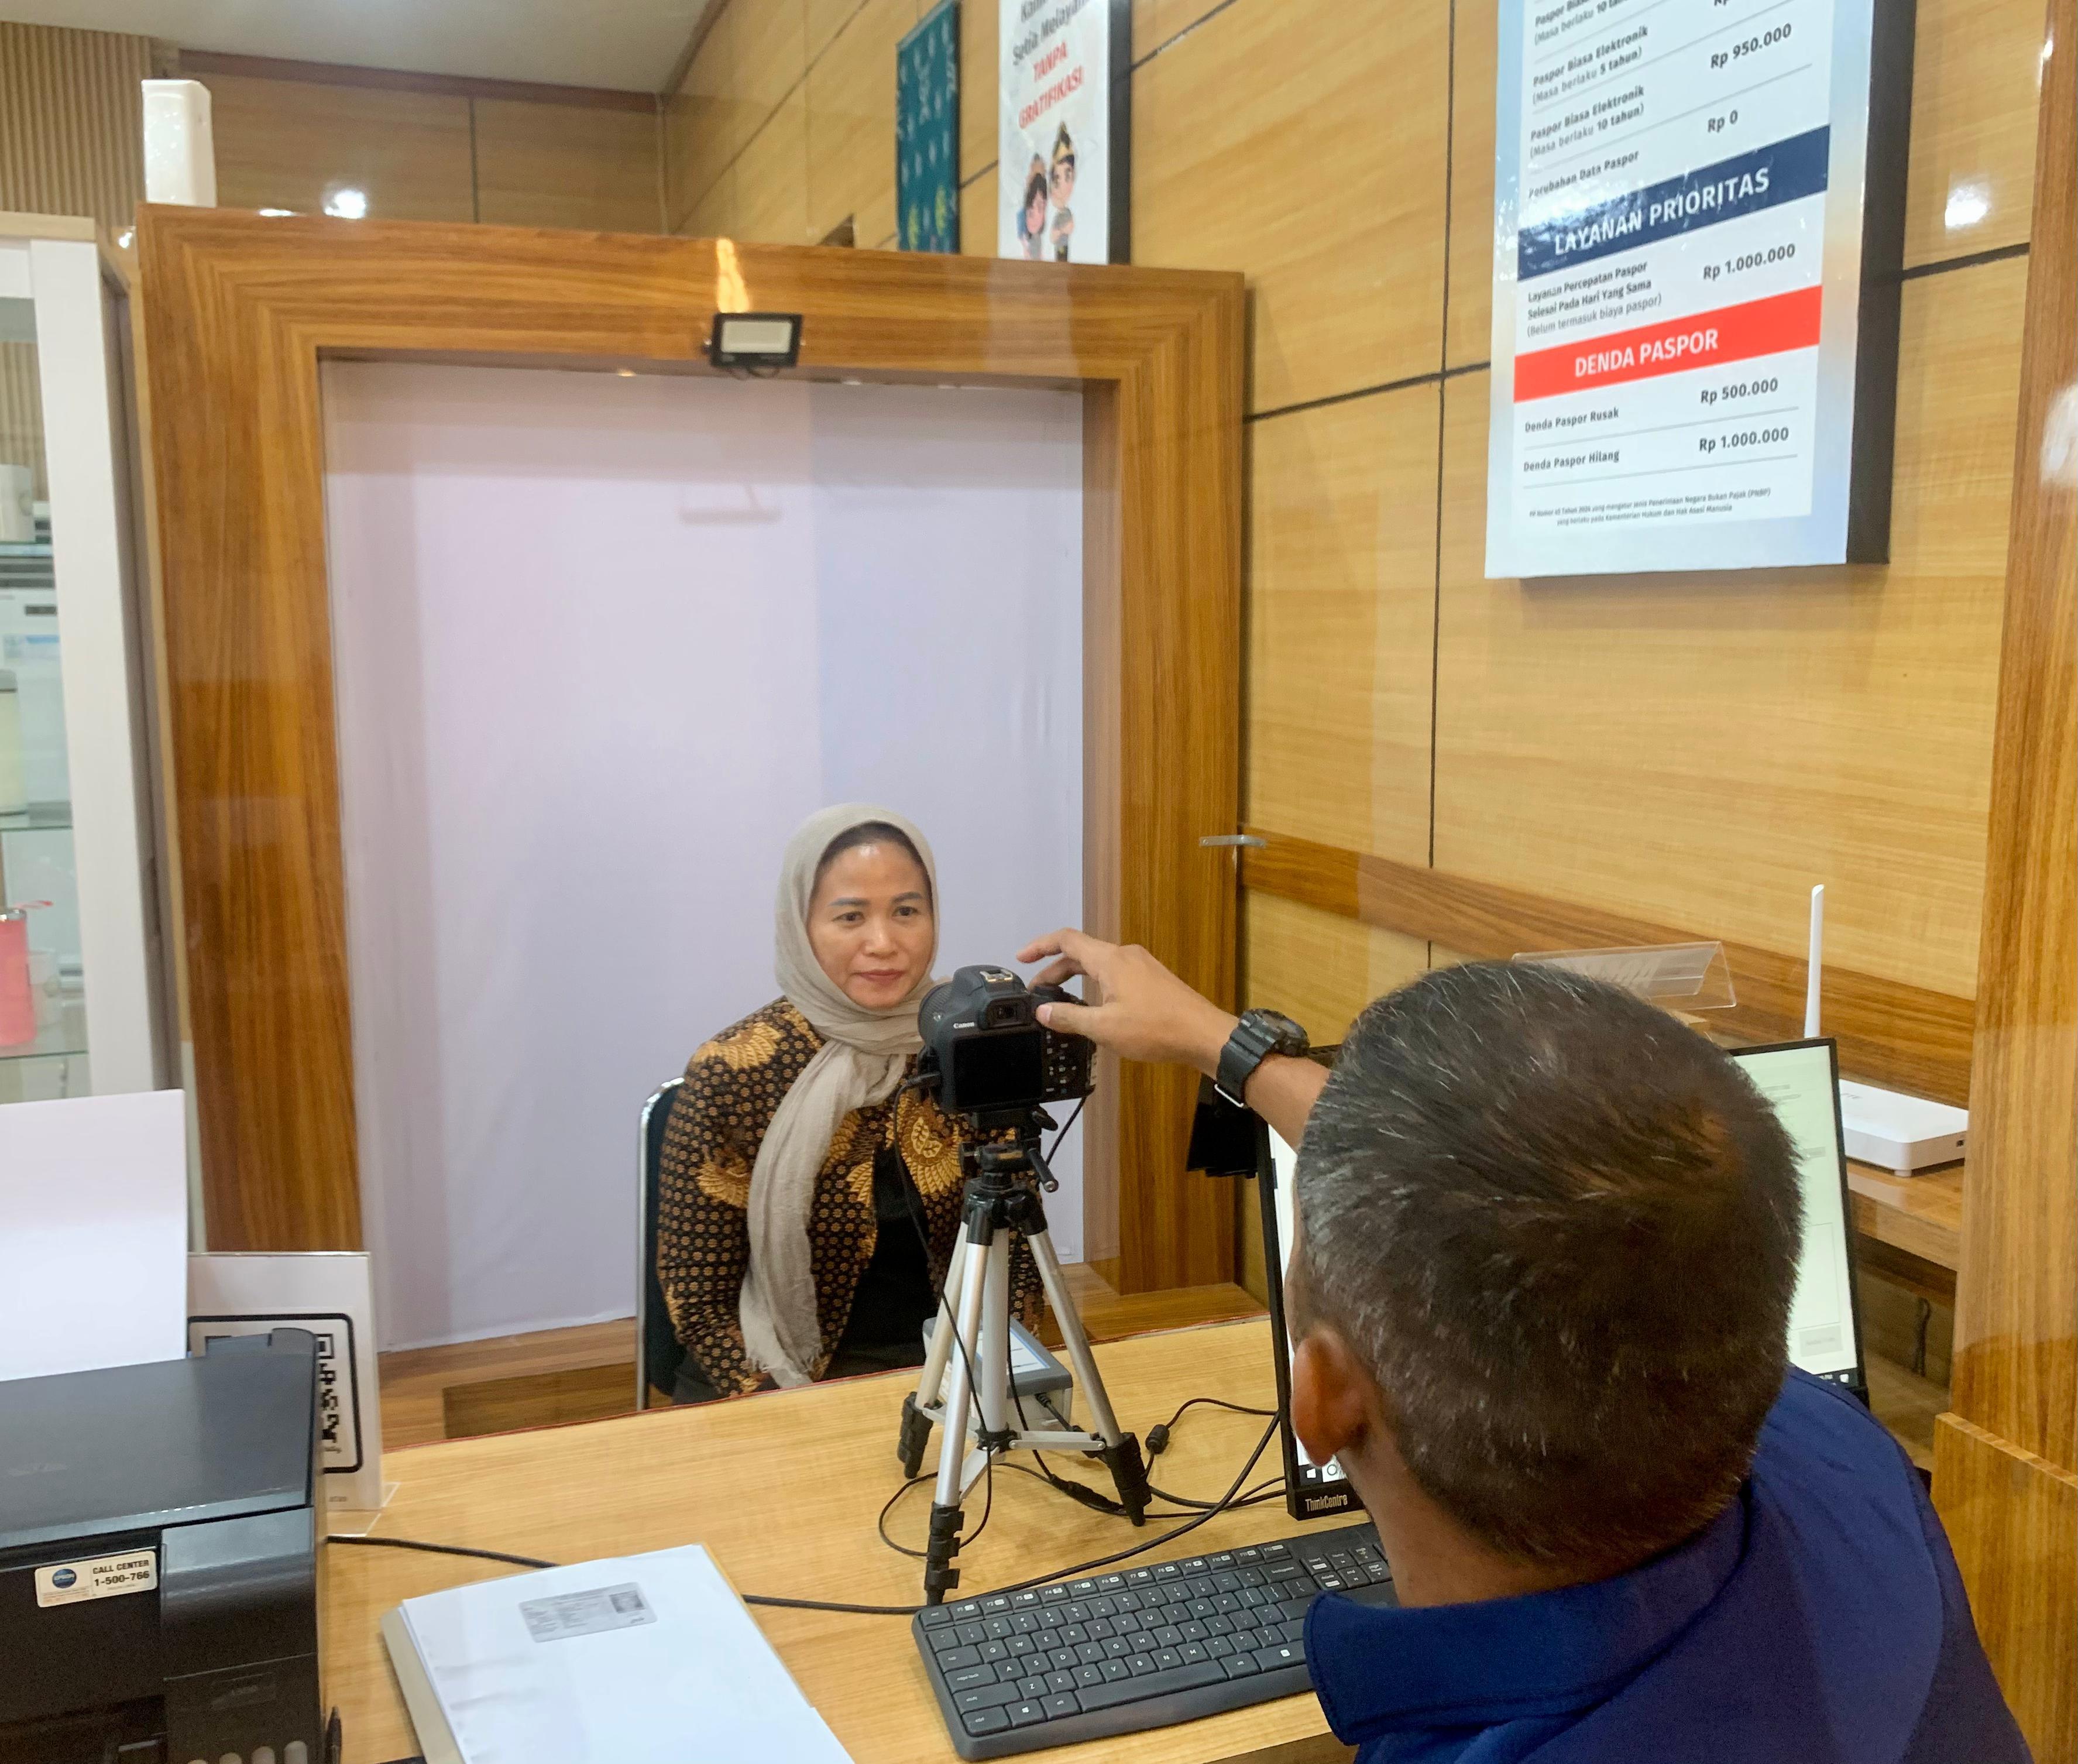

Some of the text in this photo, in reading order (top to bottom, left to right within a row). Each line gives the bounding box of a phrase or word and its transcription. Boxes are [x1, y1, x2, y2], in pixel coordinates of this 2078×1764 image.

[1033, 39, 1067, 83] TANPA
[1533, 25, 1648, 87] Paspor Biasa Elektronik
[1711, 23, 1792, 69] Rp 950.000
[1533, 46, 1642, 105] (Masa berlaku 5 tahun)
[1019, 64, 1083, 129] GRATIFIKASI
[1531, 84, 1644, 142] Paspor Biasa Elektronik
[1530, 102, 1644, 159] (Masa berlaku 10 tahun)
[1708, 109, 1738, 133] Rp 0
[1579, 164, 1602, 181] Data
[1604, 150, 1640, 171] Paspor
[1555, 167, 1770, 255] LAYANAN PRIORITAS
[1703, 243, 1795, 282] Rp 1.000.000
[1528, 262, 1648, 303] Layanan Percepatan Paspor
[1528, 279, 1651, 321] Selesai Pada Hari Yang Sama
[1527, 293, 1662, 338] (Belum termasuk biaya paspor)
[1575, 328, 1719, 378] DENDA PASPOR
[1701, 377, 1778, 406] Rp 500.000
[1525, 406, 1619, 433] Denda Paspor Rusak
[1699, 427, 1789, 454] Rp 1.000.000
[1524, 450, 1620, 472] Denda Paspor Hilang
[1689, 506, 1705, 514] Asasi
[1706, 504, 1732, 512] Manusia
[1729, 490, 1746, 499] Pajak
[953, 1021, 974, 1029] Canon
[1305, 1494, 1348, 1512] ThinkCentre
[92, 1559, 149, 1574] CALL CENTER
[95, 1570, 150, 1587] 1-500-766
